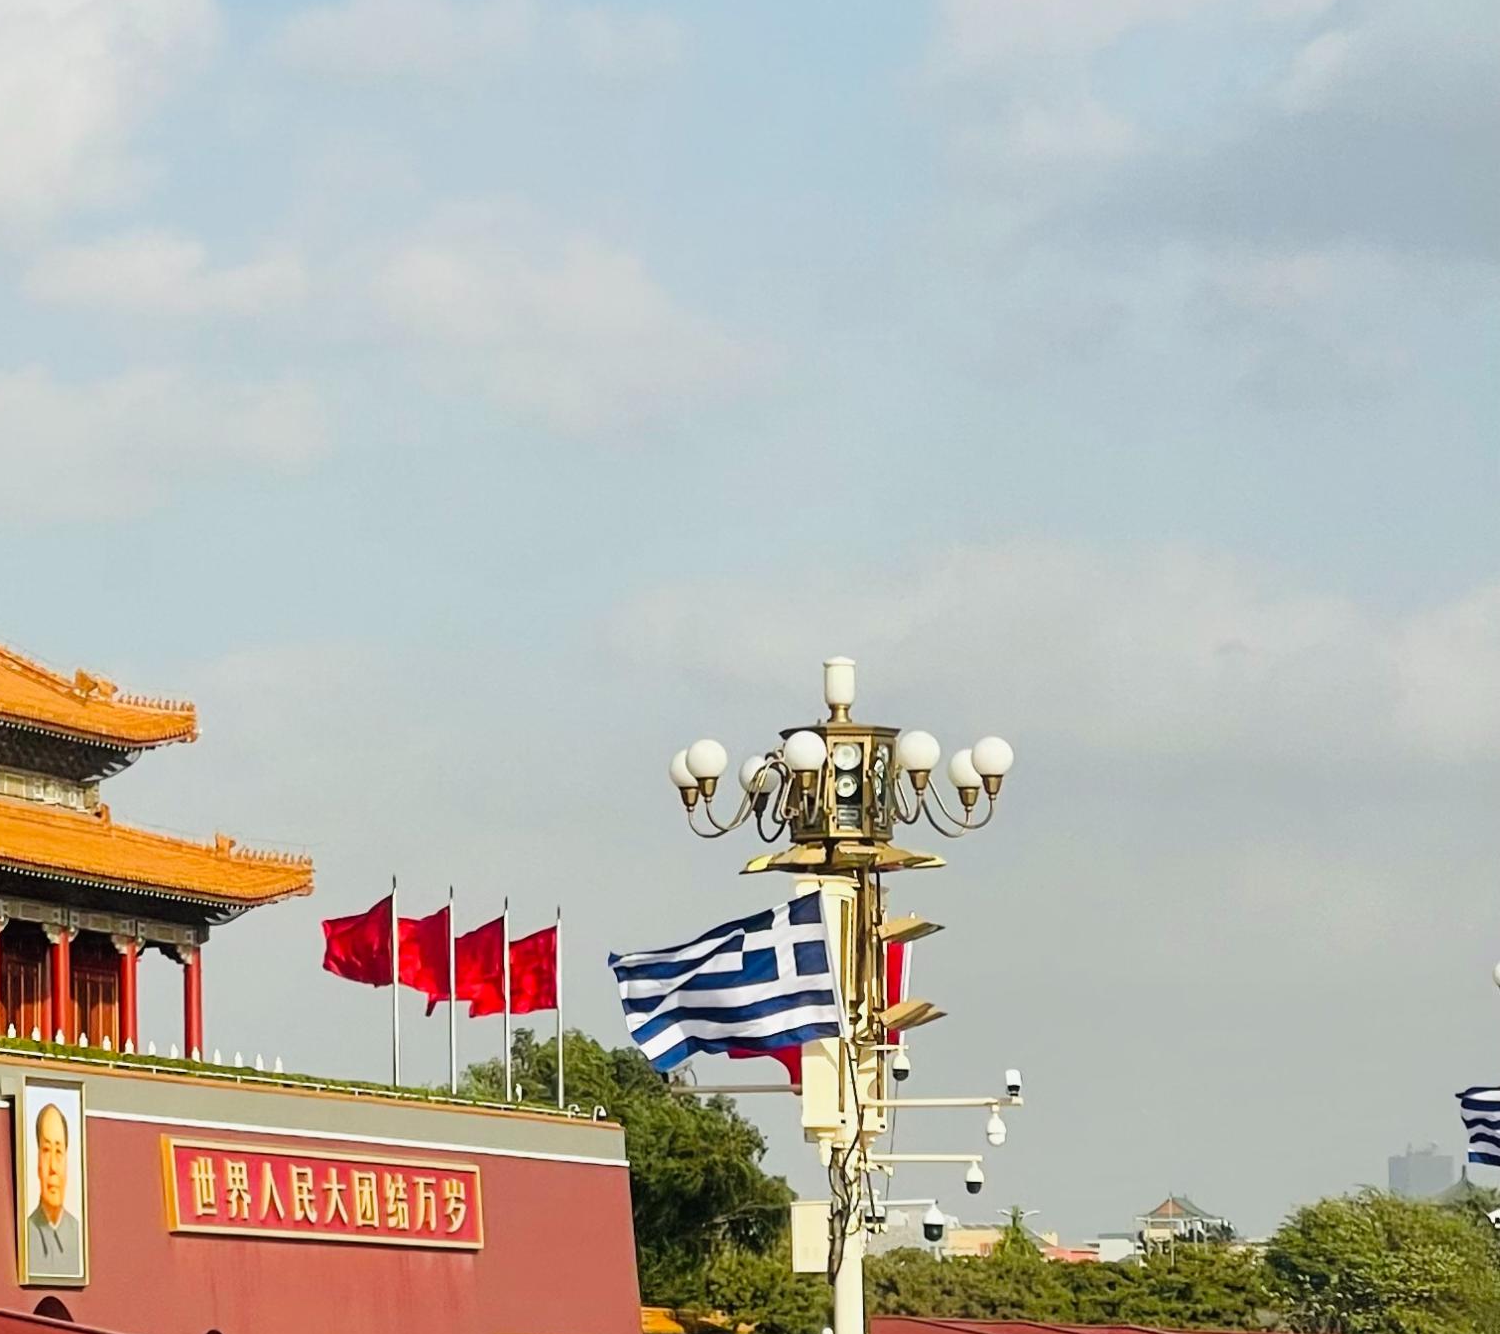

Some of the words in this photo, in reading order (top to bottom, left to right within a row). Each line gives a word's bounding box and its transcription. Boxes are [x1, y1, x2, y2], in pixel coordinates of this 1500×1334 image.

[190, 1156, 468, 1234] 世界人民大团结万岁
